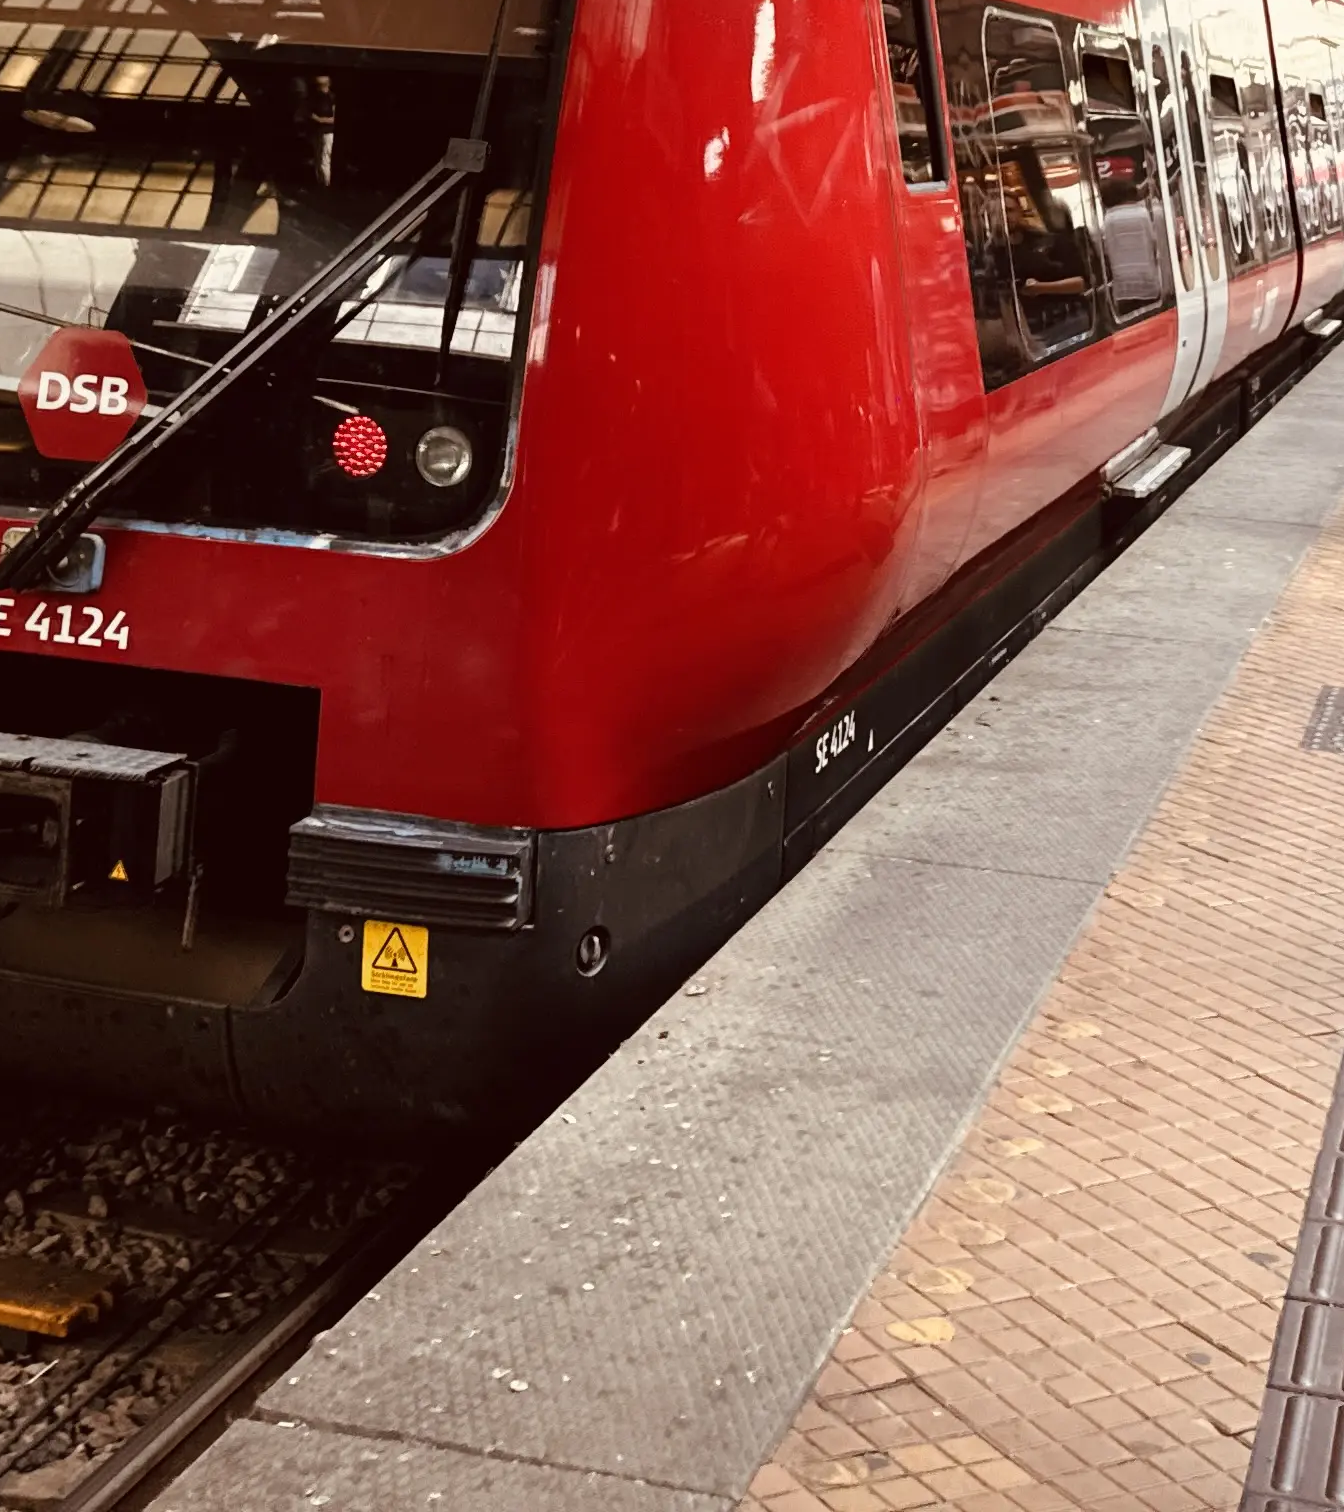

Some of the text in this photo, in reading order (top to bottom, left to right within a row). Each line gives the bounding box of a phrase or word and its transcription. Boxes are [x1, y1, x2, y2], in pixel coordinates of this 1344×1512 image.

[36, 371, 129, 416] DSB
[24, 601, 130, 650] 4124
[816, 710, 856, 774] SE 4124
